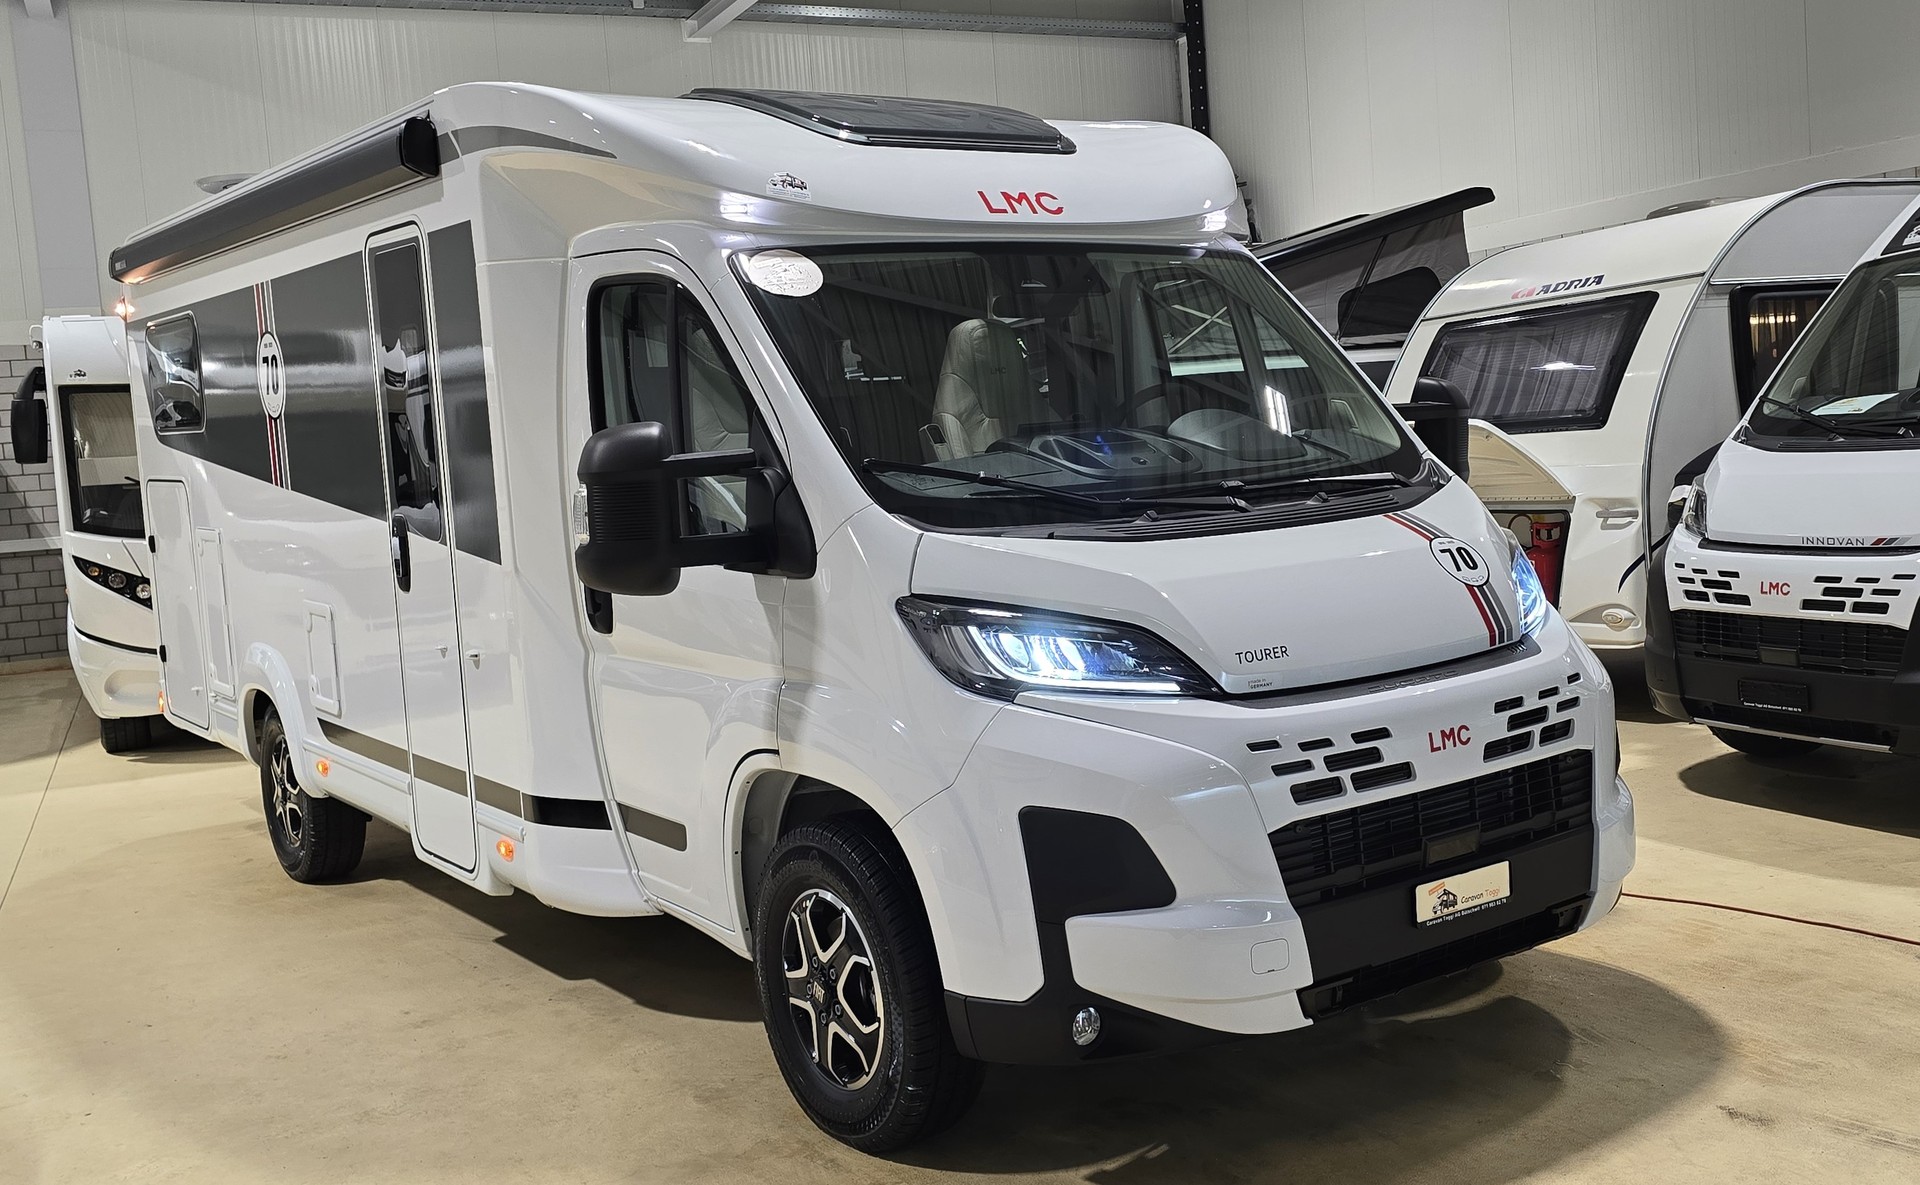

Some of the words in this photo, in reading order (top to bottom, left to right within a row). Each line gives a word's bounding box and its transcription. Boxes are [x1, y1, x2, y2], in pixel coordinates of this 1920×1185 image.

[977, 190, 1064, 216] LMC
[1536, 274, 1605, 296] ADRIA
[262, 354, 279, 395] 70
[1801, 536, 1865, 546] INNOVAN
[1438, 546, 1479, 572] 70
[1760, 581, 1791, 596] LMC
[1235, 645, 1290, 665] TOURER
[1428, 724, 1472, 753] LMC
[1461, 893, 1483, 903] Caravan
